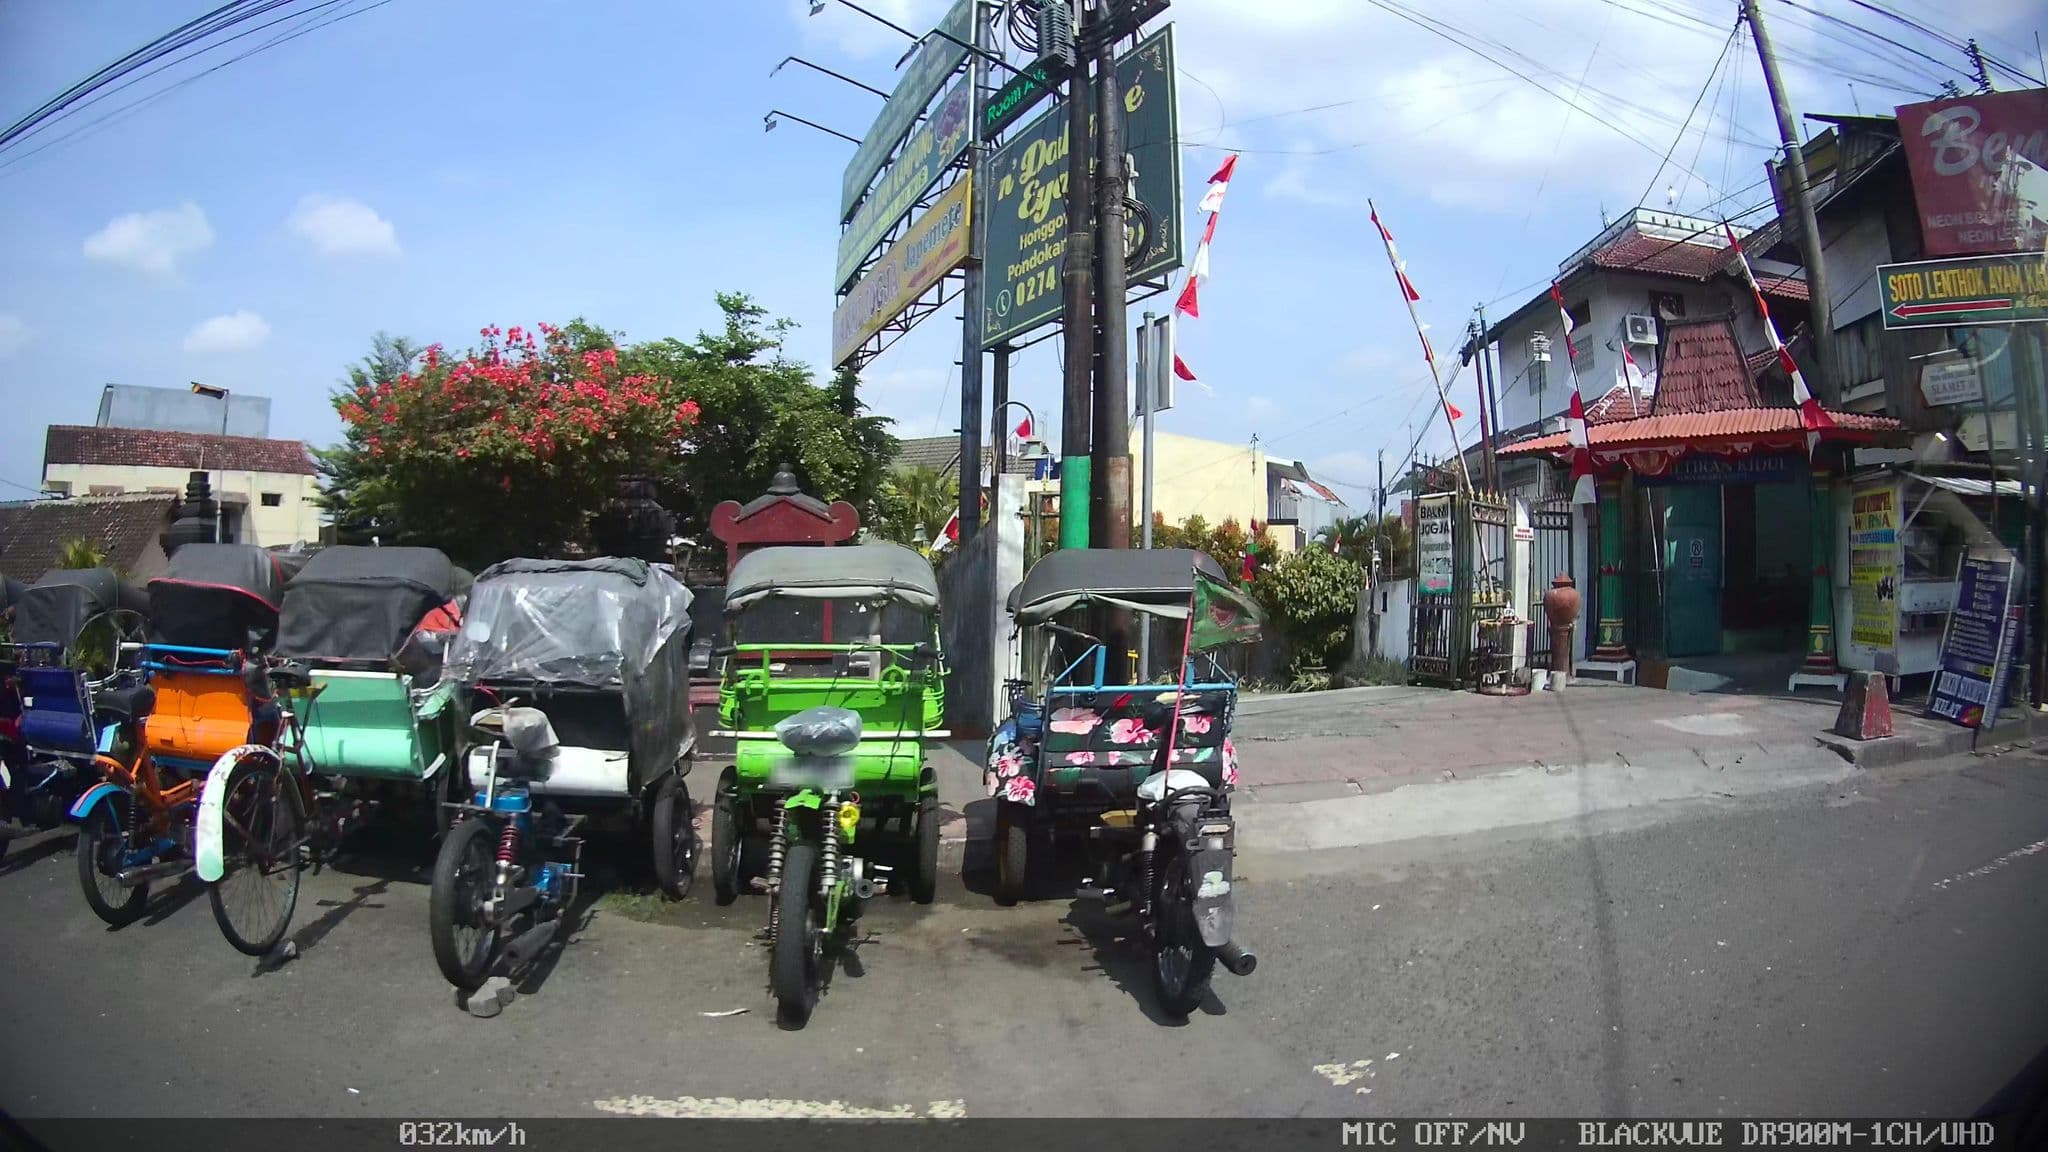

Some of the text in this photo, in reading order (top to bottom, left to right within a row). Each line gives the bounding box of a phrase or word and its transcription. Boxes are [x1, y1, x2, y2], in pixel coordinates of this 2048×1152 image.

[1016, 265, 1056, 307] 0274
[1888, 273, 1924, 302] SOTO
[1989, 263, 2024, 294] AYAM
[1420, 521, 1450, 536] JOGJA
